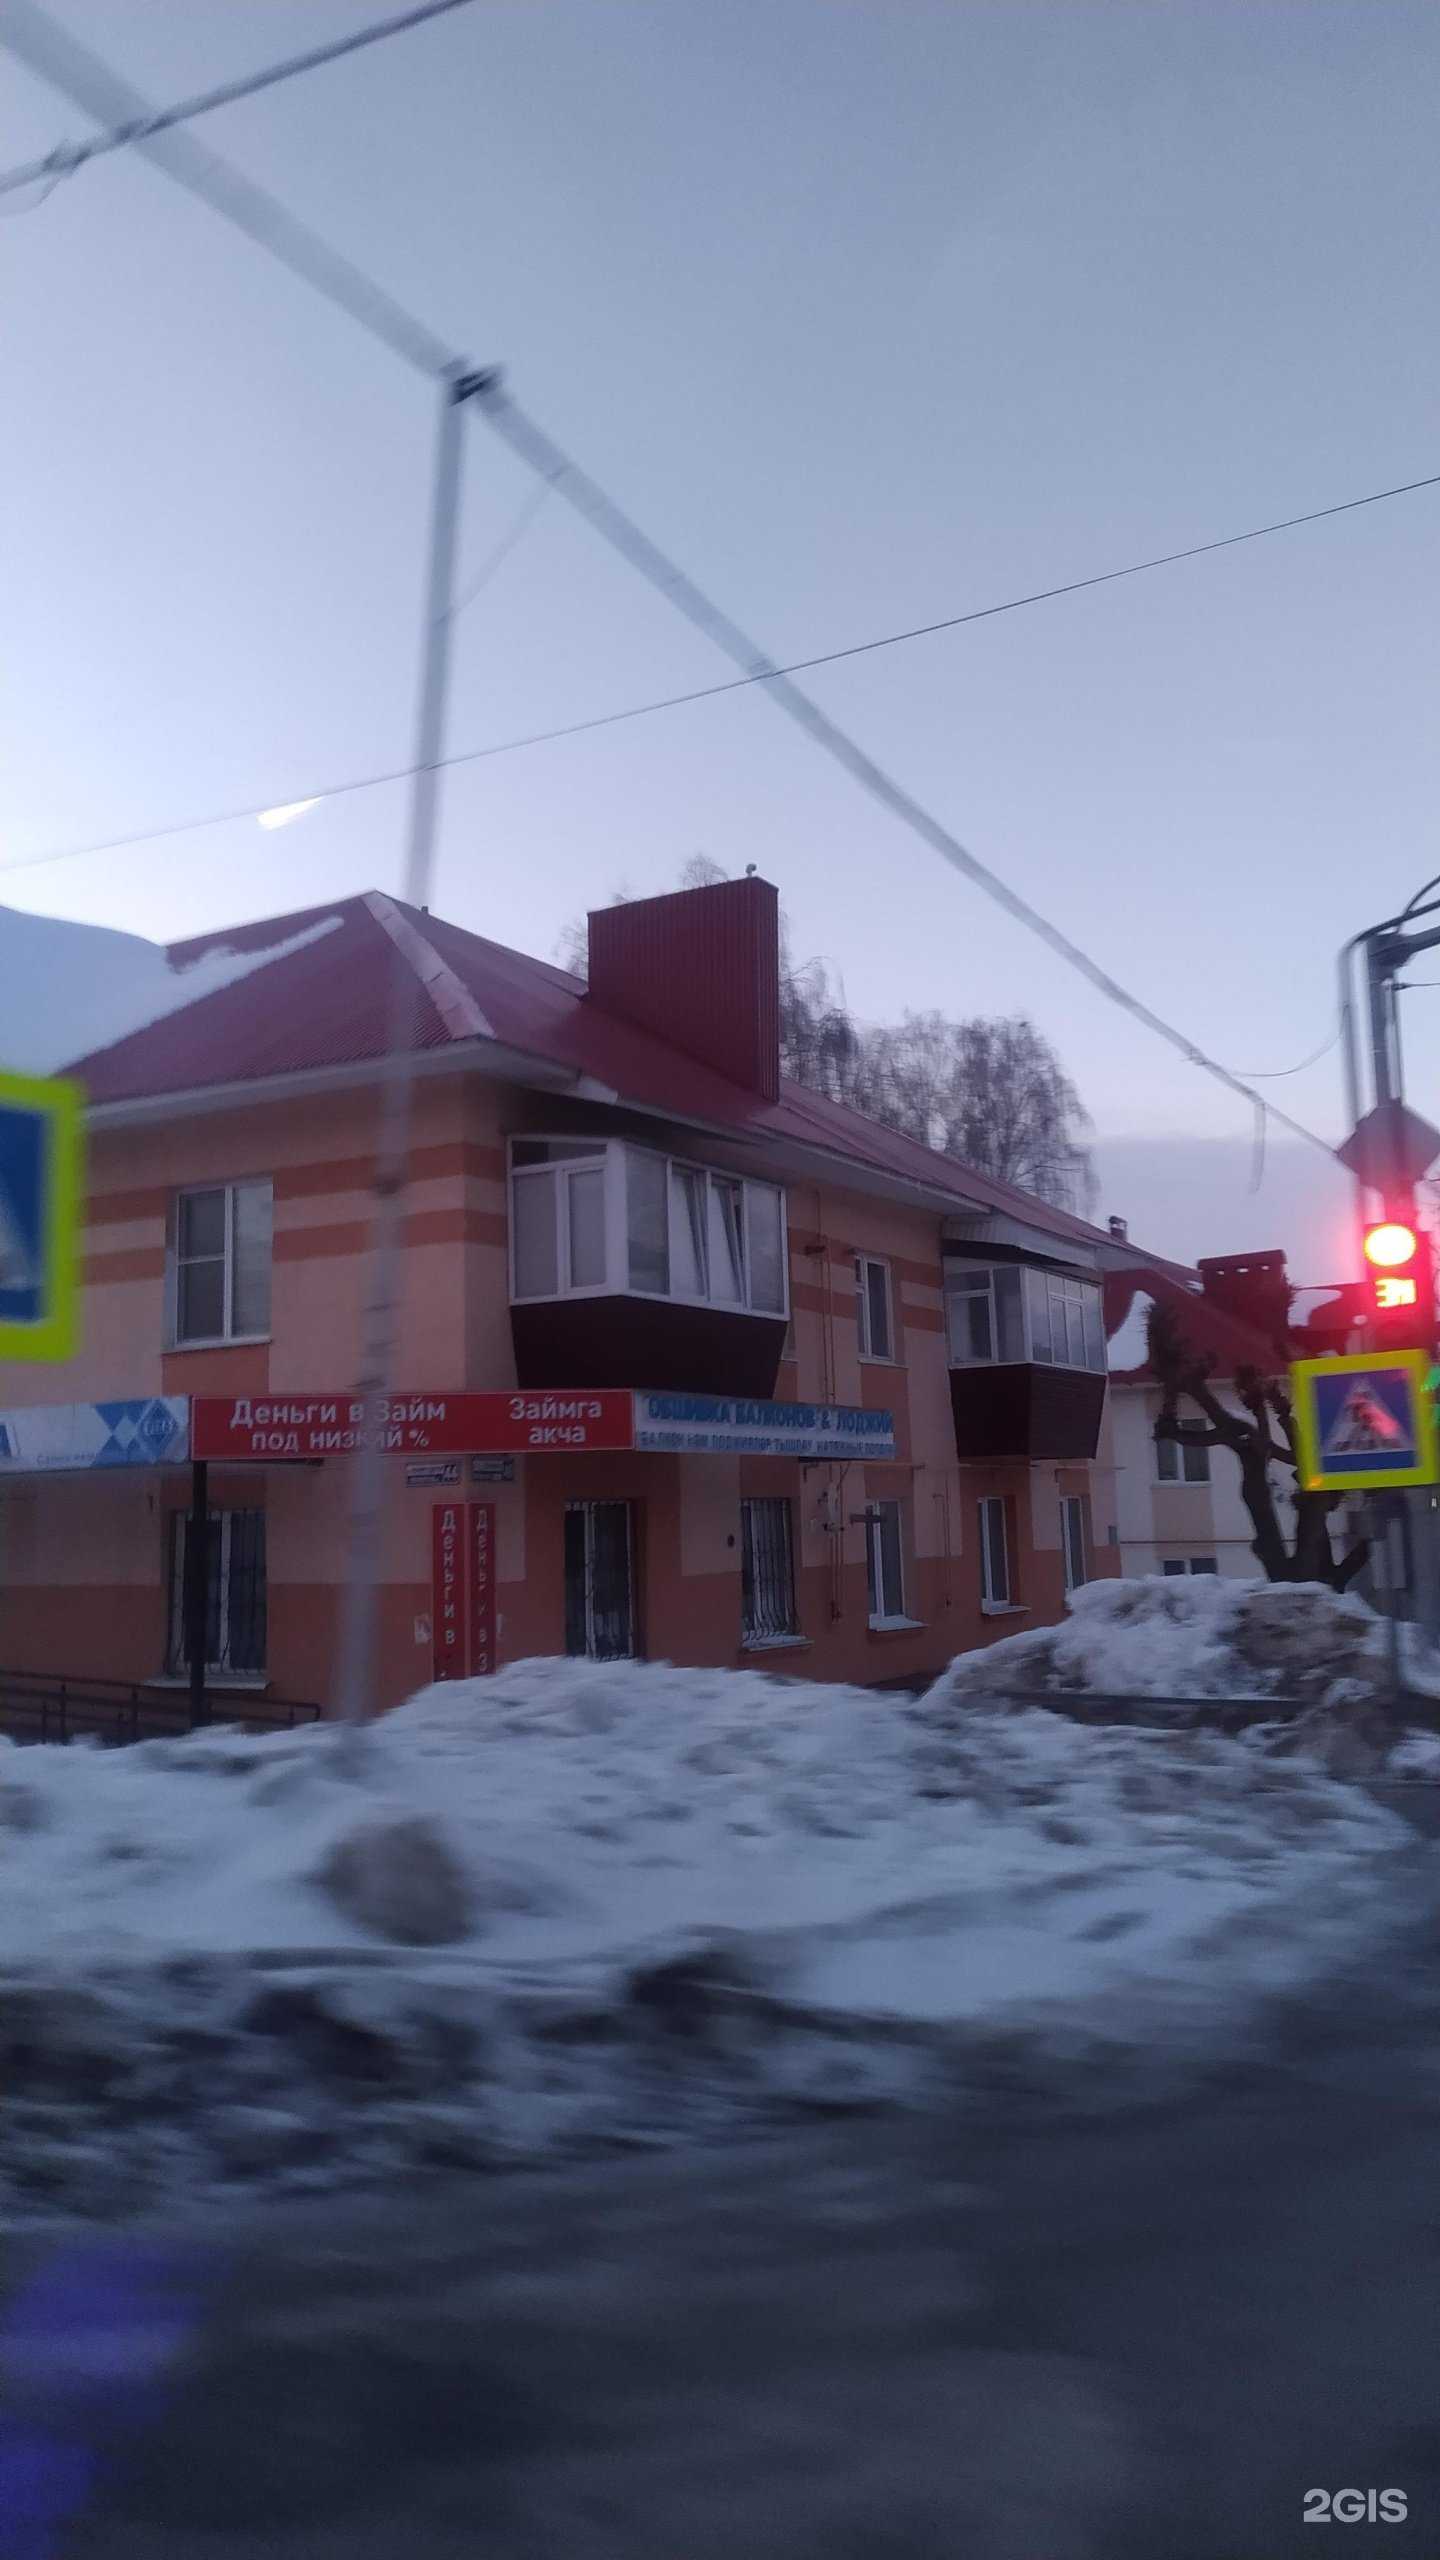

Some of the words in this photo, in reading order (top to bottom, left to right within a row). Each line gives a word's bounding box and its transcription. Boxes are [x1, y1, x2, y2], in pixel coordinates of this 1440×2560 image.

[230, 1399, 337, 1429] Деньги
[349, 1404, 364, 1422] в
[374, 1396, 446, 1422] Займ
[509, 1395, 602, 1420] Займга
[251, 1431, 299, 1452] под
[408, 1429, 430, 1448] %
[528, 1425, 586, 1444] акча
[441, 1509, 456, 1618] Деньги
